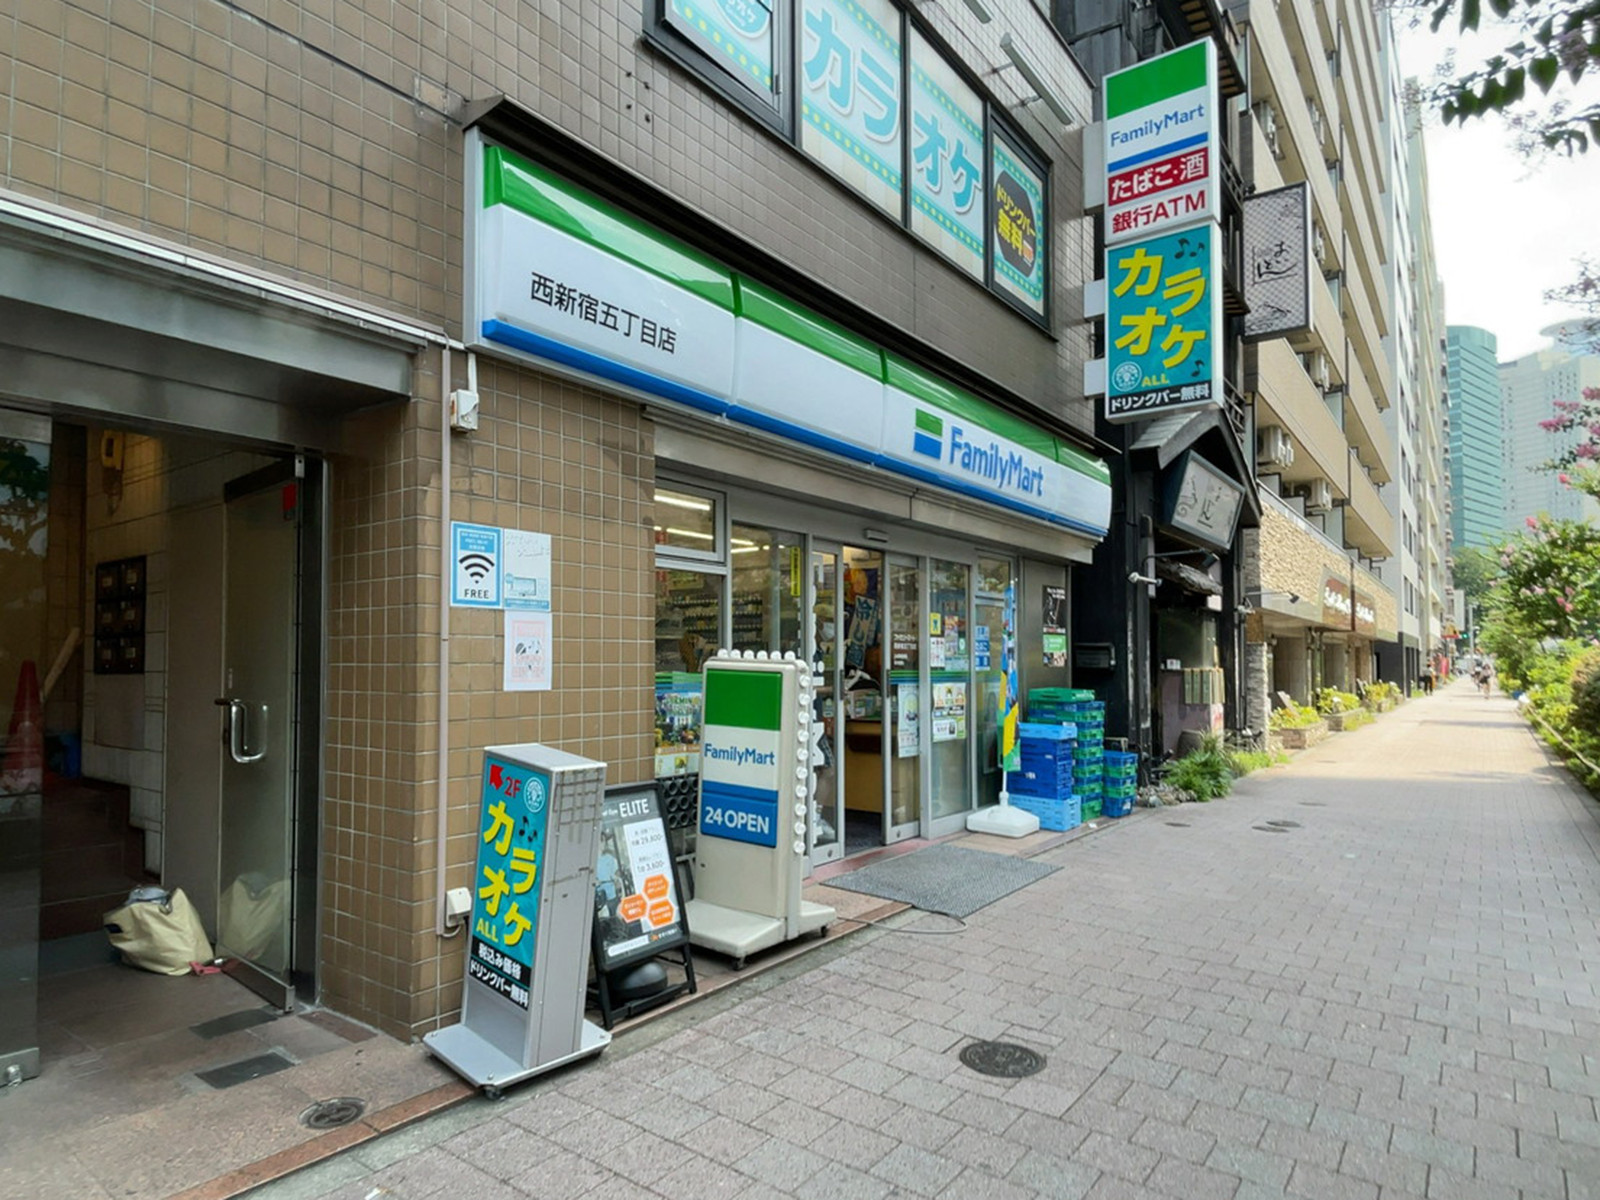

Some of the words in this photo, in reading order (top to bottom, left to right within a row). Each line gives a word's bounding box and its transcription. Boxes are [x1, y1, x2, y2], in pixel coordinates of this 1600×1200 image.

[803, 6, 982, 214] カラオケ
[1110, 104, 1205, 147] FamilyMart
[997, 184, 1036, 236] ドリンクバー
[1112, 190, 1206, 234] 銀行ATM
[531, 271, 677, 355] 西新宿五丁目店
[1112, 383, 1209, 412] ドリンクバー無料
[1141, 373, 1170, 388] ALL
[950, 426, 1044, 497] FamilyMart
[464, 588, 490, 600] FREE
[704, 743, 775, 766] FamilyMart
[504, 776, 522, 798] 2F
[619, 798, 650, 818] ELITE
[476, 918, 499, 943] ALL
[470, 960, 528, 1007] ドリンクバー無料
